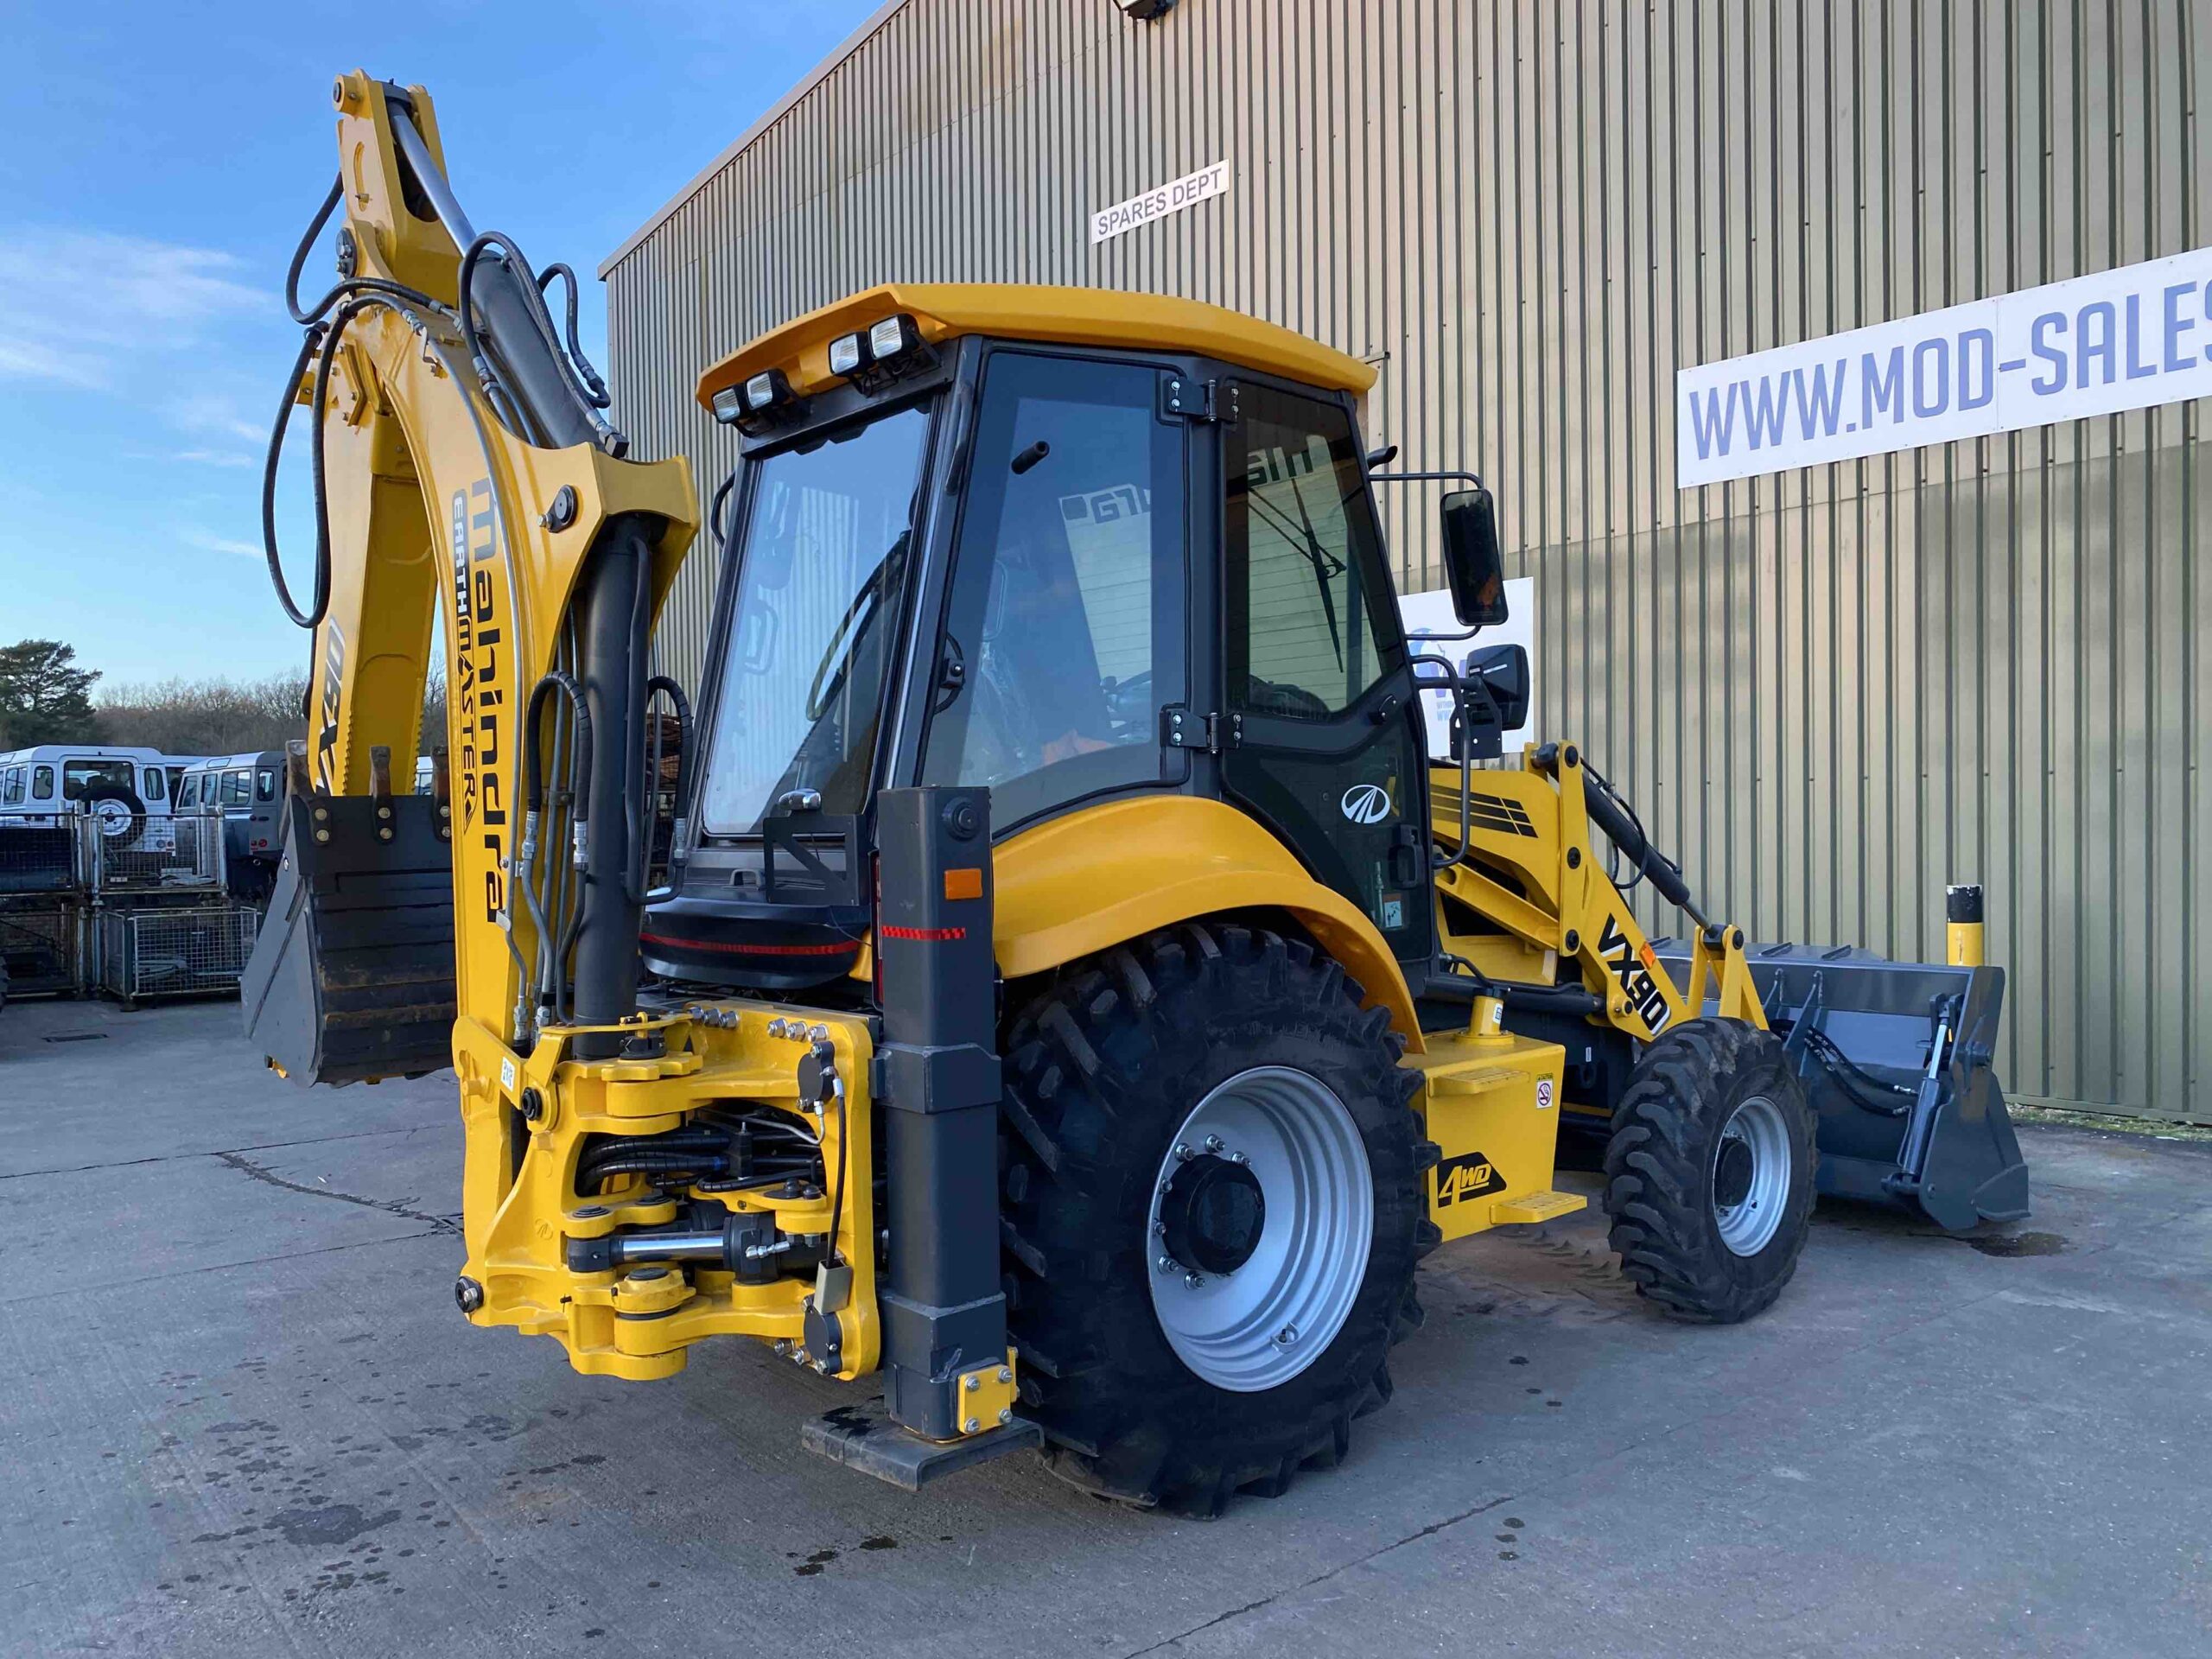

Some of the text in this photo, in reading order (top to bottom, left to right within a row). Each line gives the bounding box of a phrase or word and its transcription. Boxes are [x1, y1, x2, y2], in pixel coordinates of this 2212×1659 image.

[1098, 168, 1222, 236] SPARES DEPT
[1689, 278, 2212, 461] WWW.MOD-SALE
[471, 477, 505, 924] mahindra
[1598, 912, 1671, 1035] VX90
[1438, 1163, 1492, 1206] 4WD
